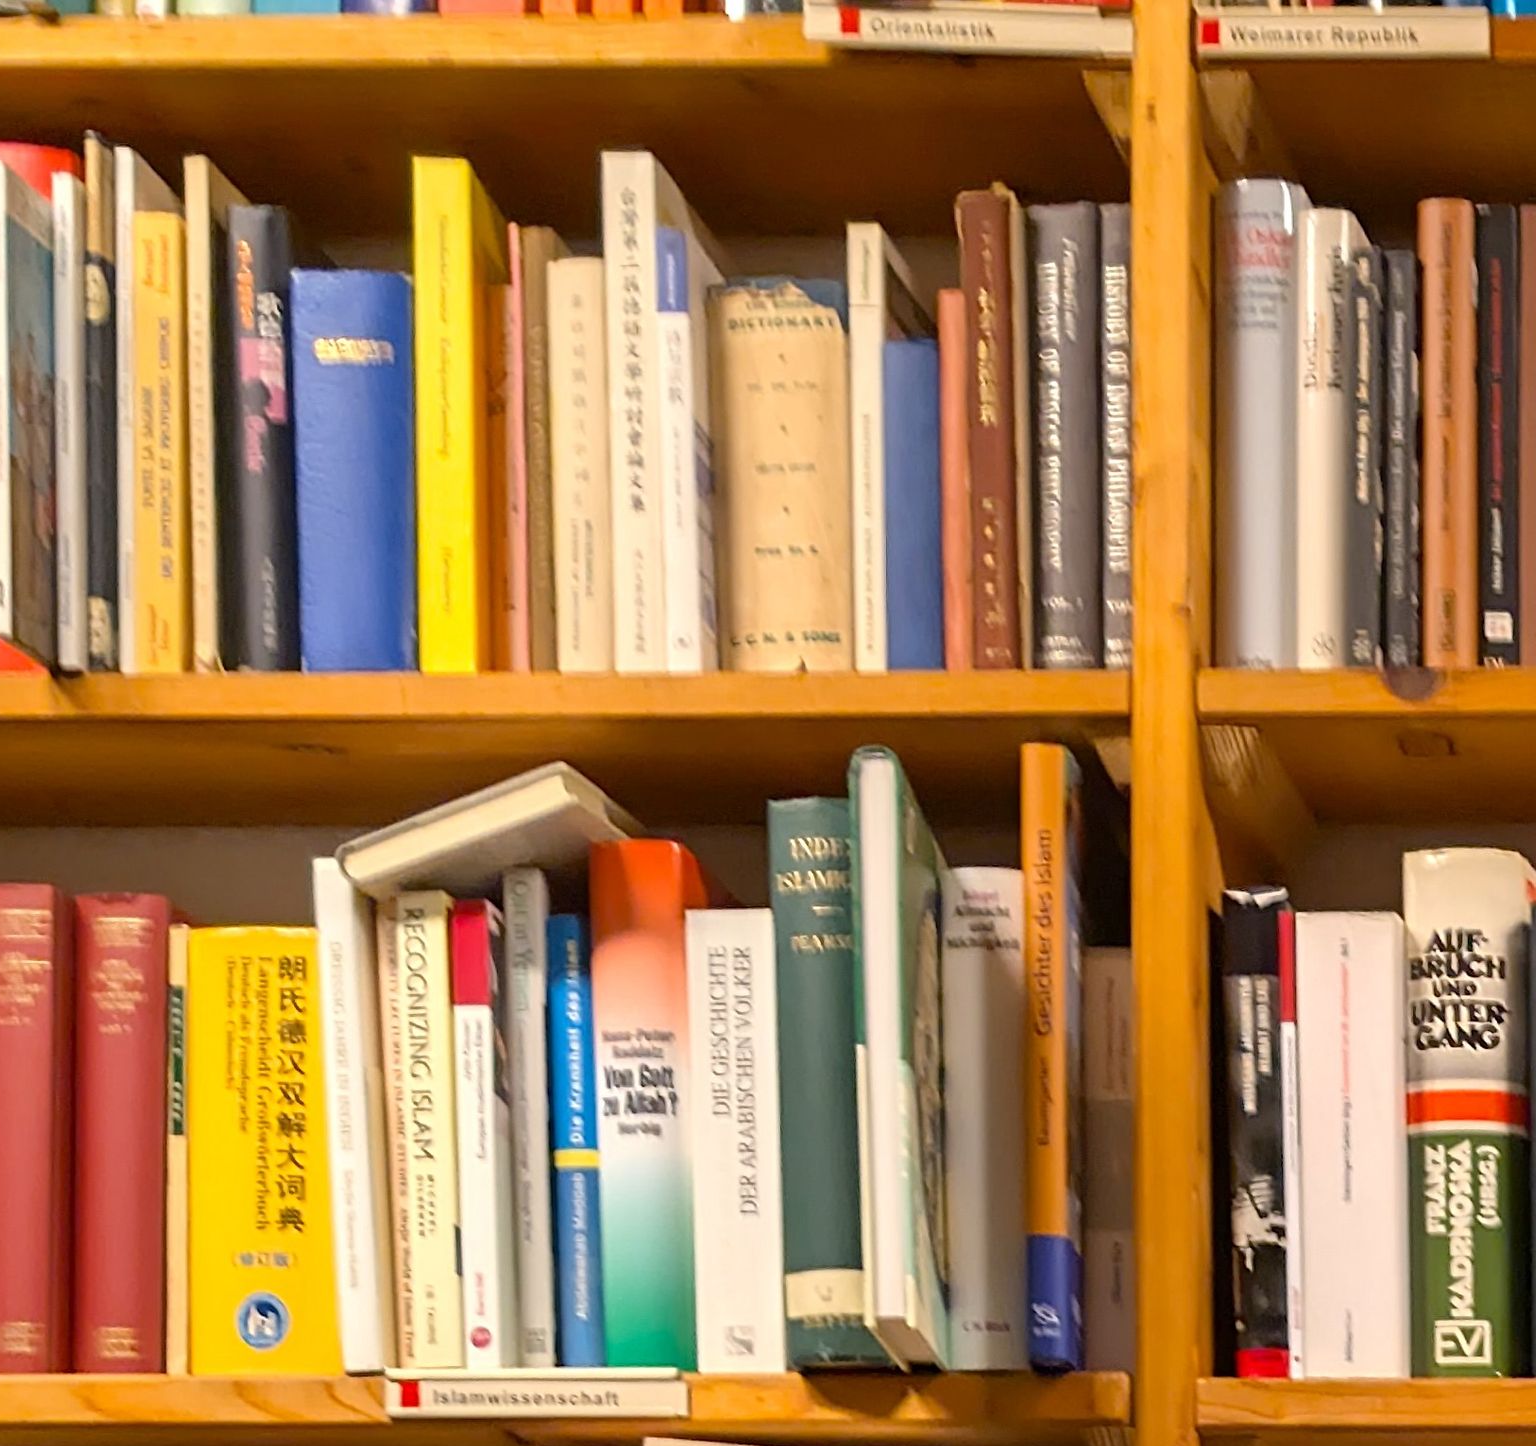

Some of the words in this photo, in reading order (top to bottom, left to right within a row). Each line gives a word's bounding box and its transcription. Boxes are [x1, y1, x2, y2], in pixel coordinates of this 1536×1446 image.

[872, 16, 994, 37] Orientalistik
[1230, 26, 1322, 44] Weimarer
[1332, 26, 1419, 46] Republik
[400, 908, 430, 1076] RECOGNIZING
[709, 946, 729, 1076] GESCHICHTE
[728, 946, 753, 1029] VÖLKER
[407, 1087, 434, 1158] ISLAM
[711, 1082, 728, 1116] DIE
[736, 1034, 757, 1173] ARABISCHEN
[740, 1179, 759, 1215] DER
[1424, 1144, 1447, 1234] FRANZ
[1447, 1139, 1475, 1319] KADRNOSKA
